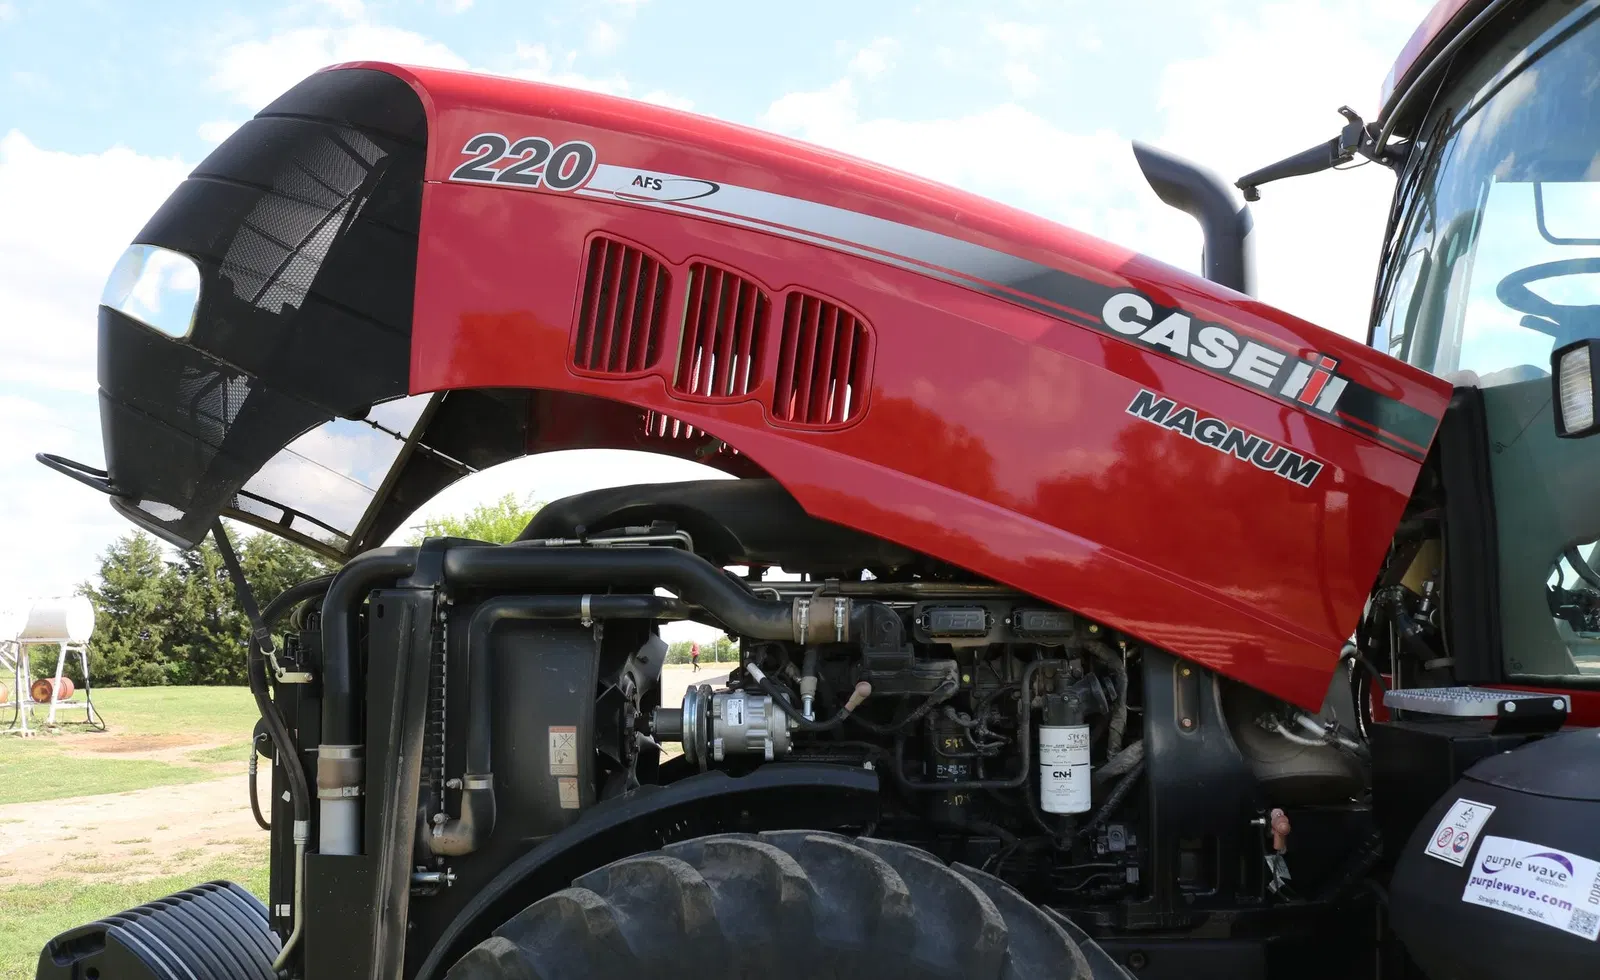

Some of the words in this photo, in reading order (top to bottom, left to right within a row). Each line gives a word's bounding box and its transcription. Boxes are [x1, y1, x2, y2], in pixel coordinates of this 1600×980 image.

[449, 133, 596, 191] 220
[631, 175, 663, 191] AFS
[1102, 292, 1287, 389] CASE
[1125, 388, 1324, 487] MAGNUM
[1485, 854, 1523, 869] purple
[1527, 862, 1568, 882] wave
[1535, 876, 1565, 888] auction
[1469, 875, 1573, 912] purplewave.com
[1527, 908, 1546, 919] Sold.
